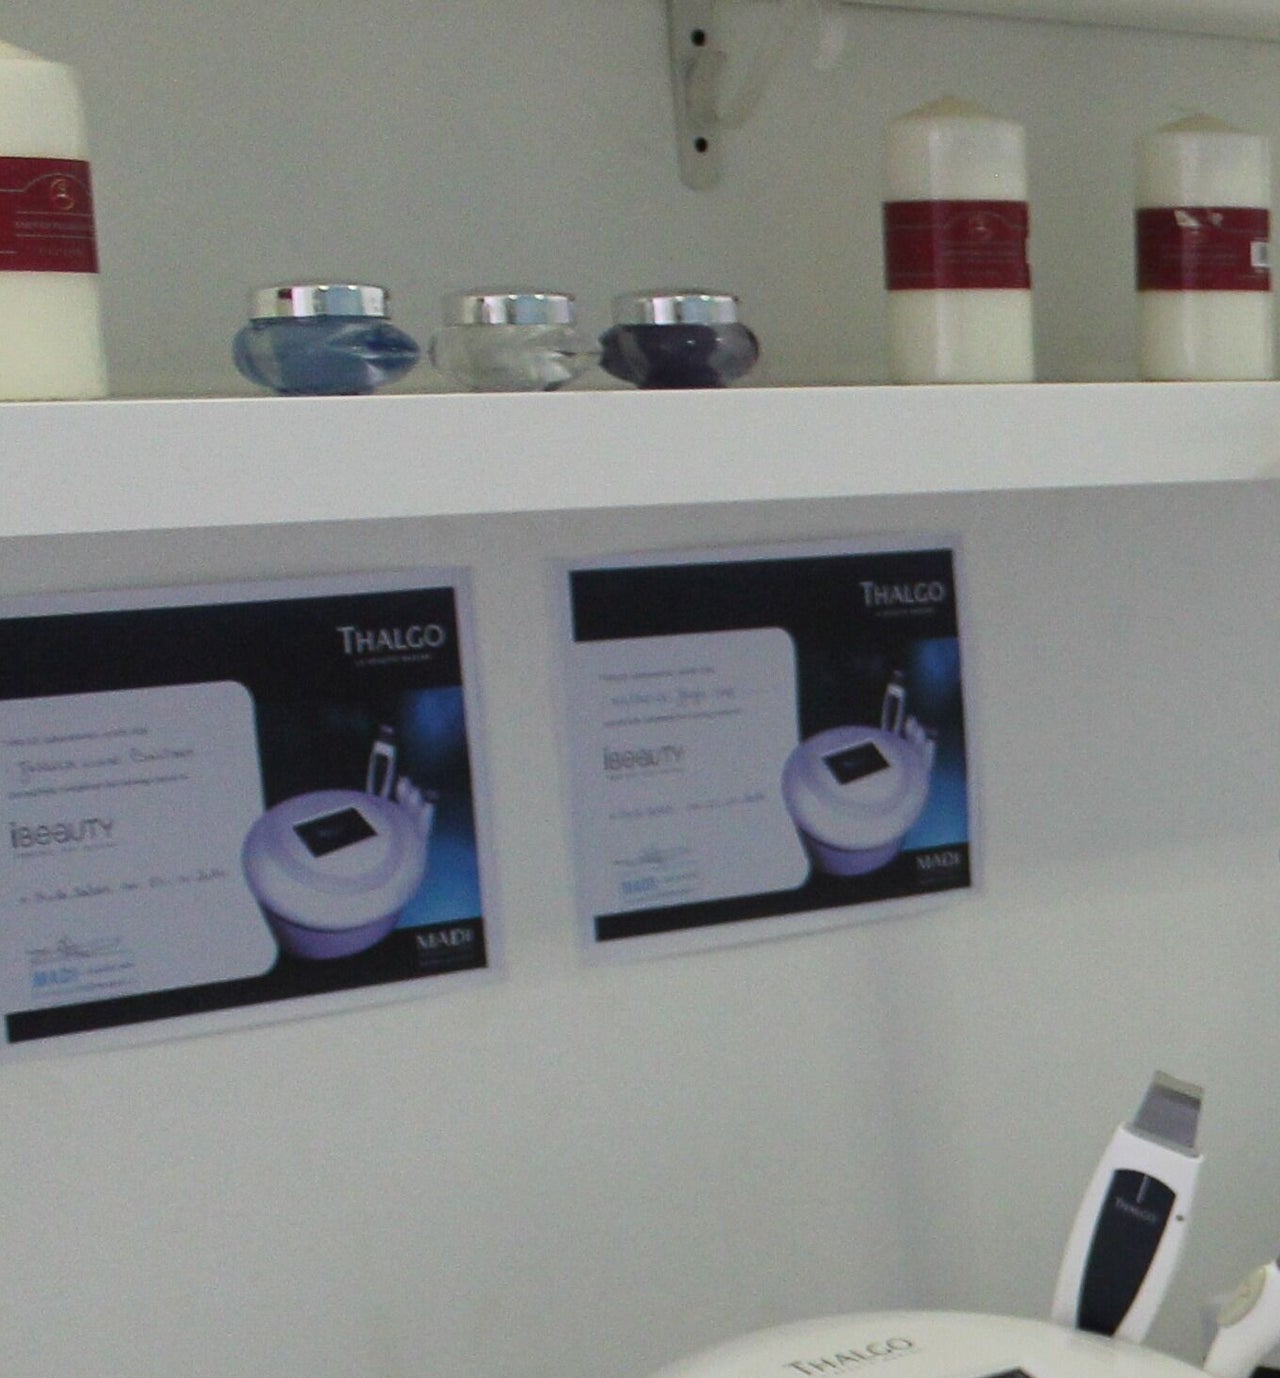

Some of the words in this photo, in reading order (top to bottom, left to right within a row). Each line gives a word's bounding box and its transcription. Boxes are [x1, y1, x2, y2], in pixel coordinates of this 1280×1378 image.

[859, 580, 946, 608] THALGO
[336, 623, 446, 655] THALGO
[782, 1337, 914, 1377] THALGO
